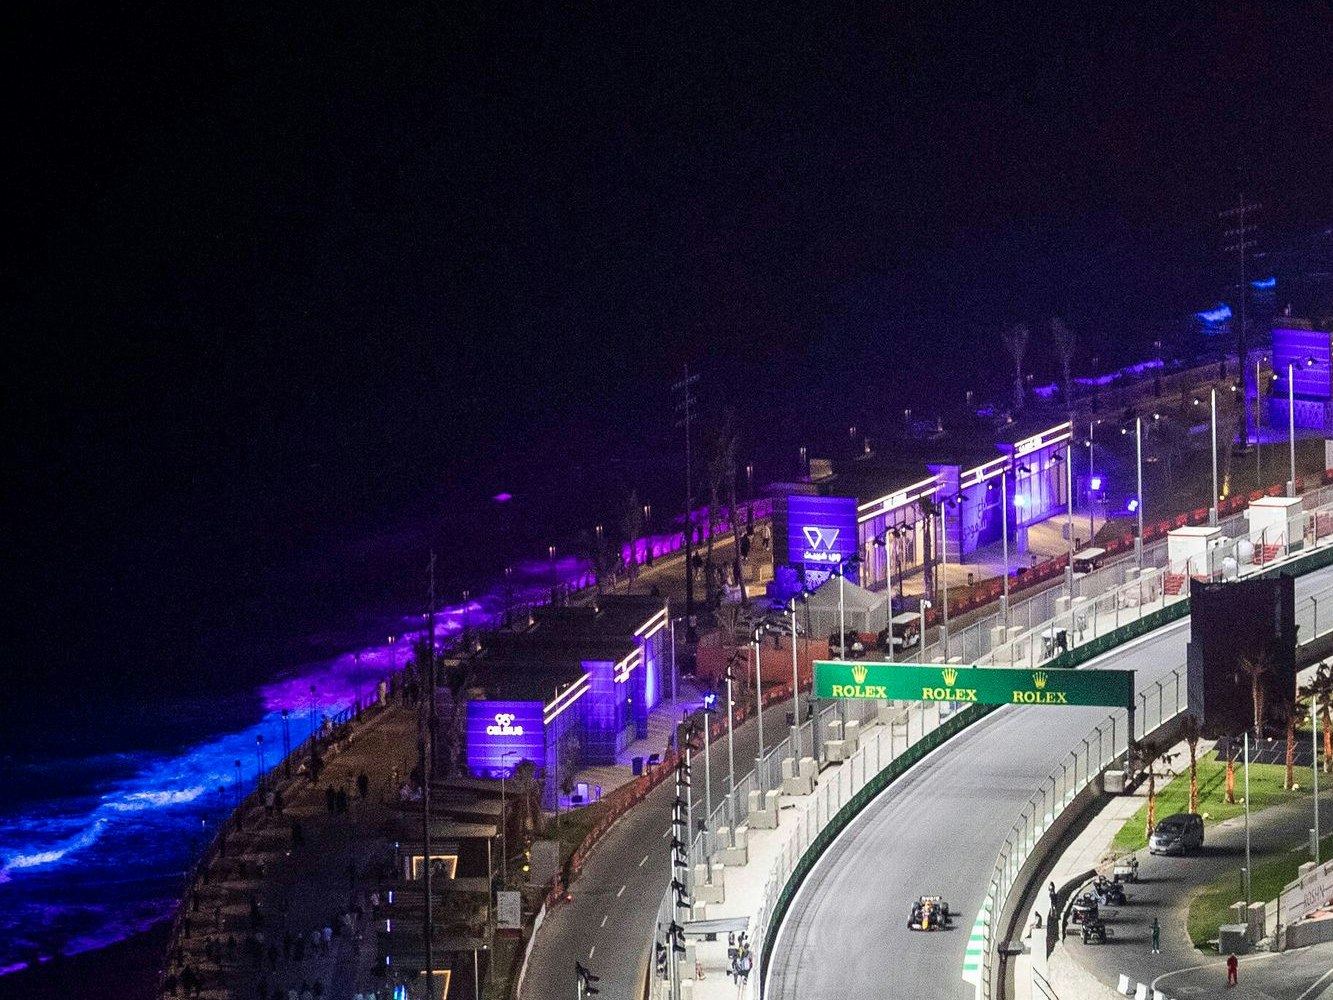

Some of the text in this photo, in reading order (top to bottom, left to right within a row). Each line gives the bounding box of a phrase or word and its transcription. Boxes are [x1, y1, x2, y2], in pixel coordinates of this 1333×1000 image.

[832, 685, 888, 698] ROLEX
[922, 687, 978, 701] ROLEX
[1012, 691, 1068, 703] ROLEX
